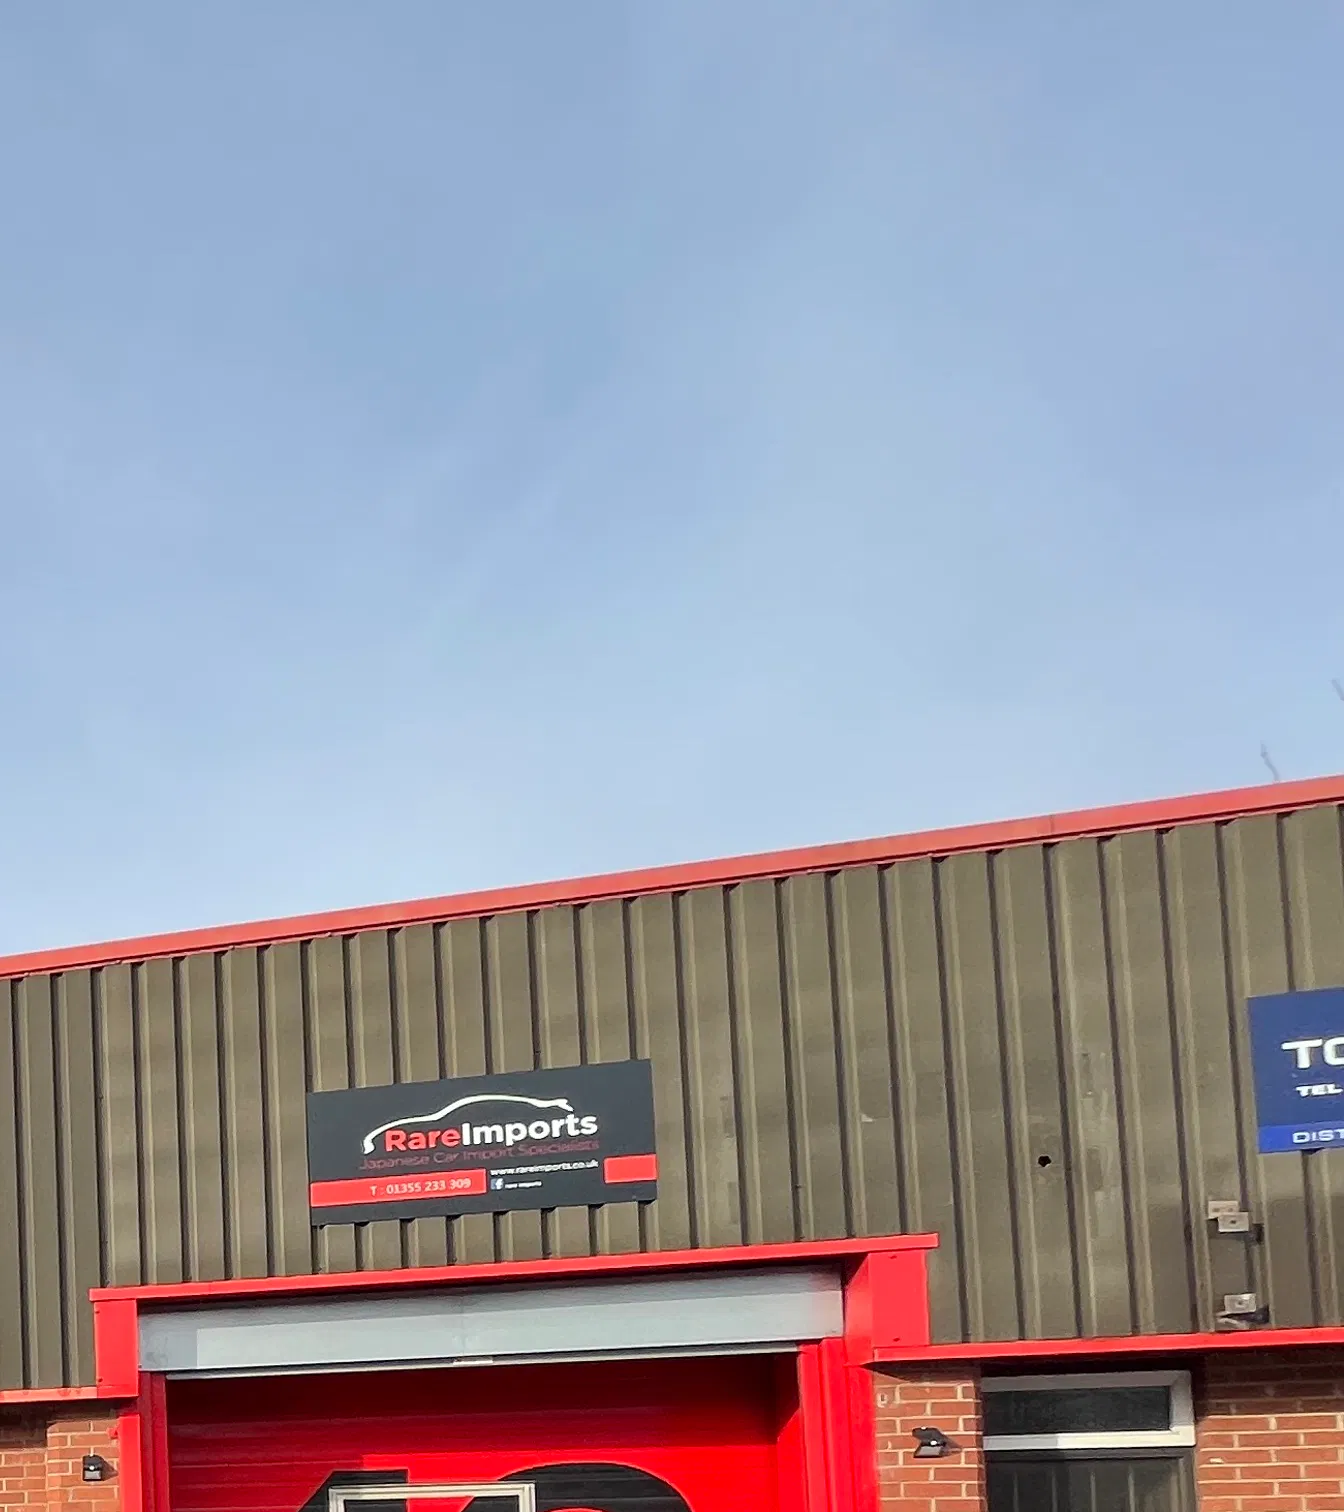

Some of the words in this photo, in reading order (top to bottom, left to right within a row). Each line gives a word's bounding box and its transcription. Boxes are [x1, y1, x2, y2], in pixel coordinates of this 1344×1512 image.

[385, 1114, 598, 1152] RareImports
[433, 1151, 460, 1164] Car
[386, 1182, 422, 1195] 01355
[424, 1180, 446, 1192] 233
